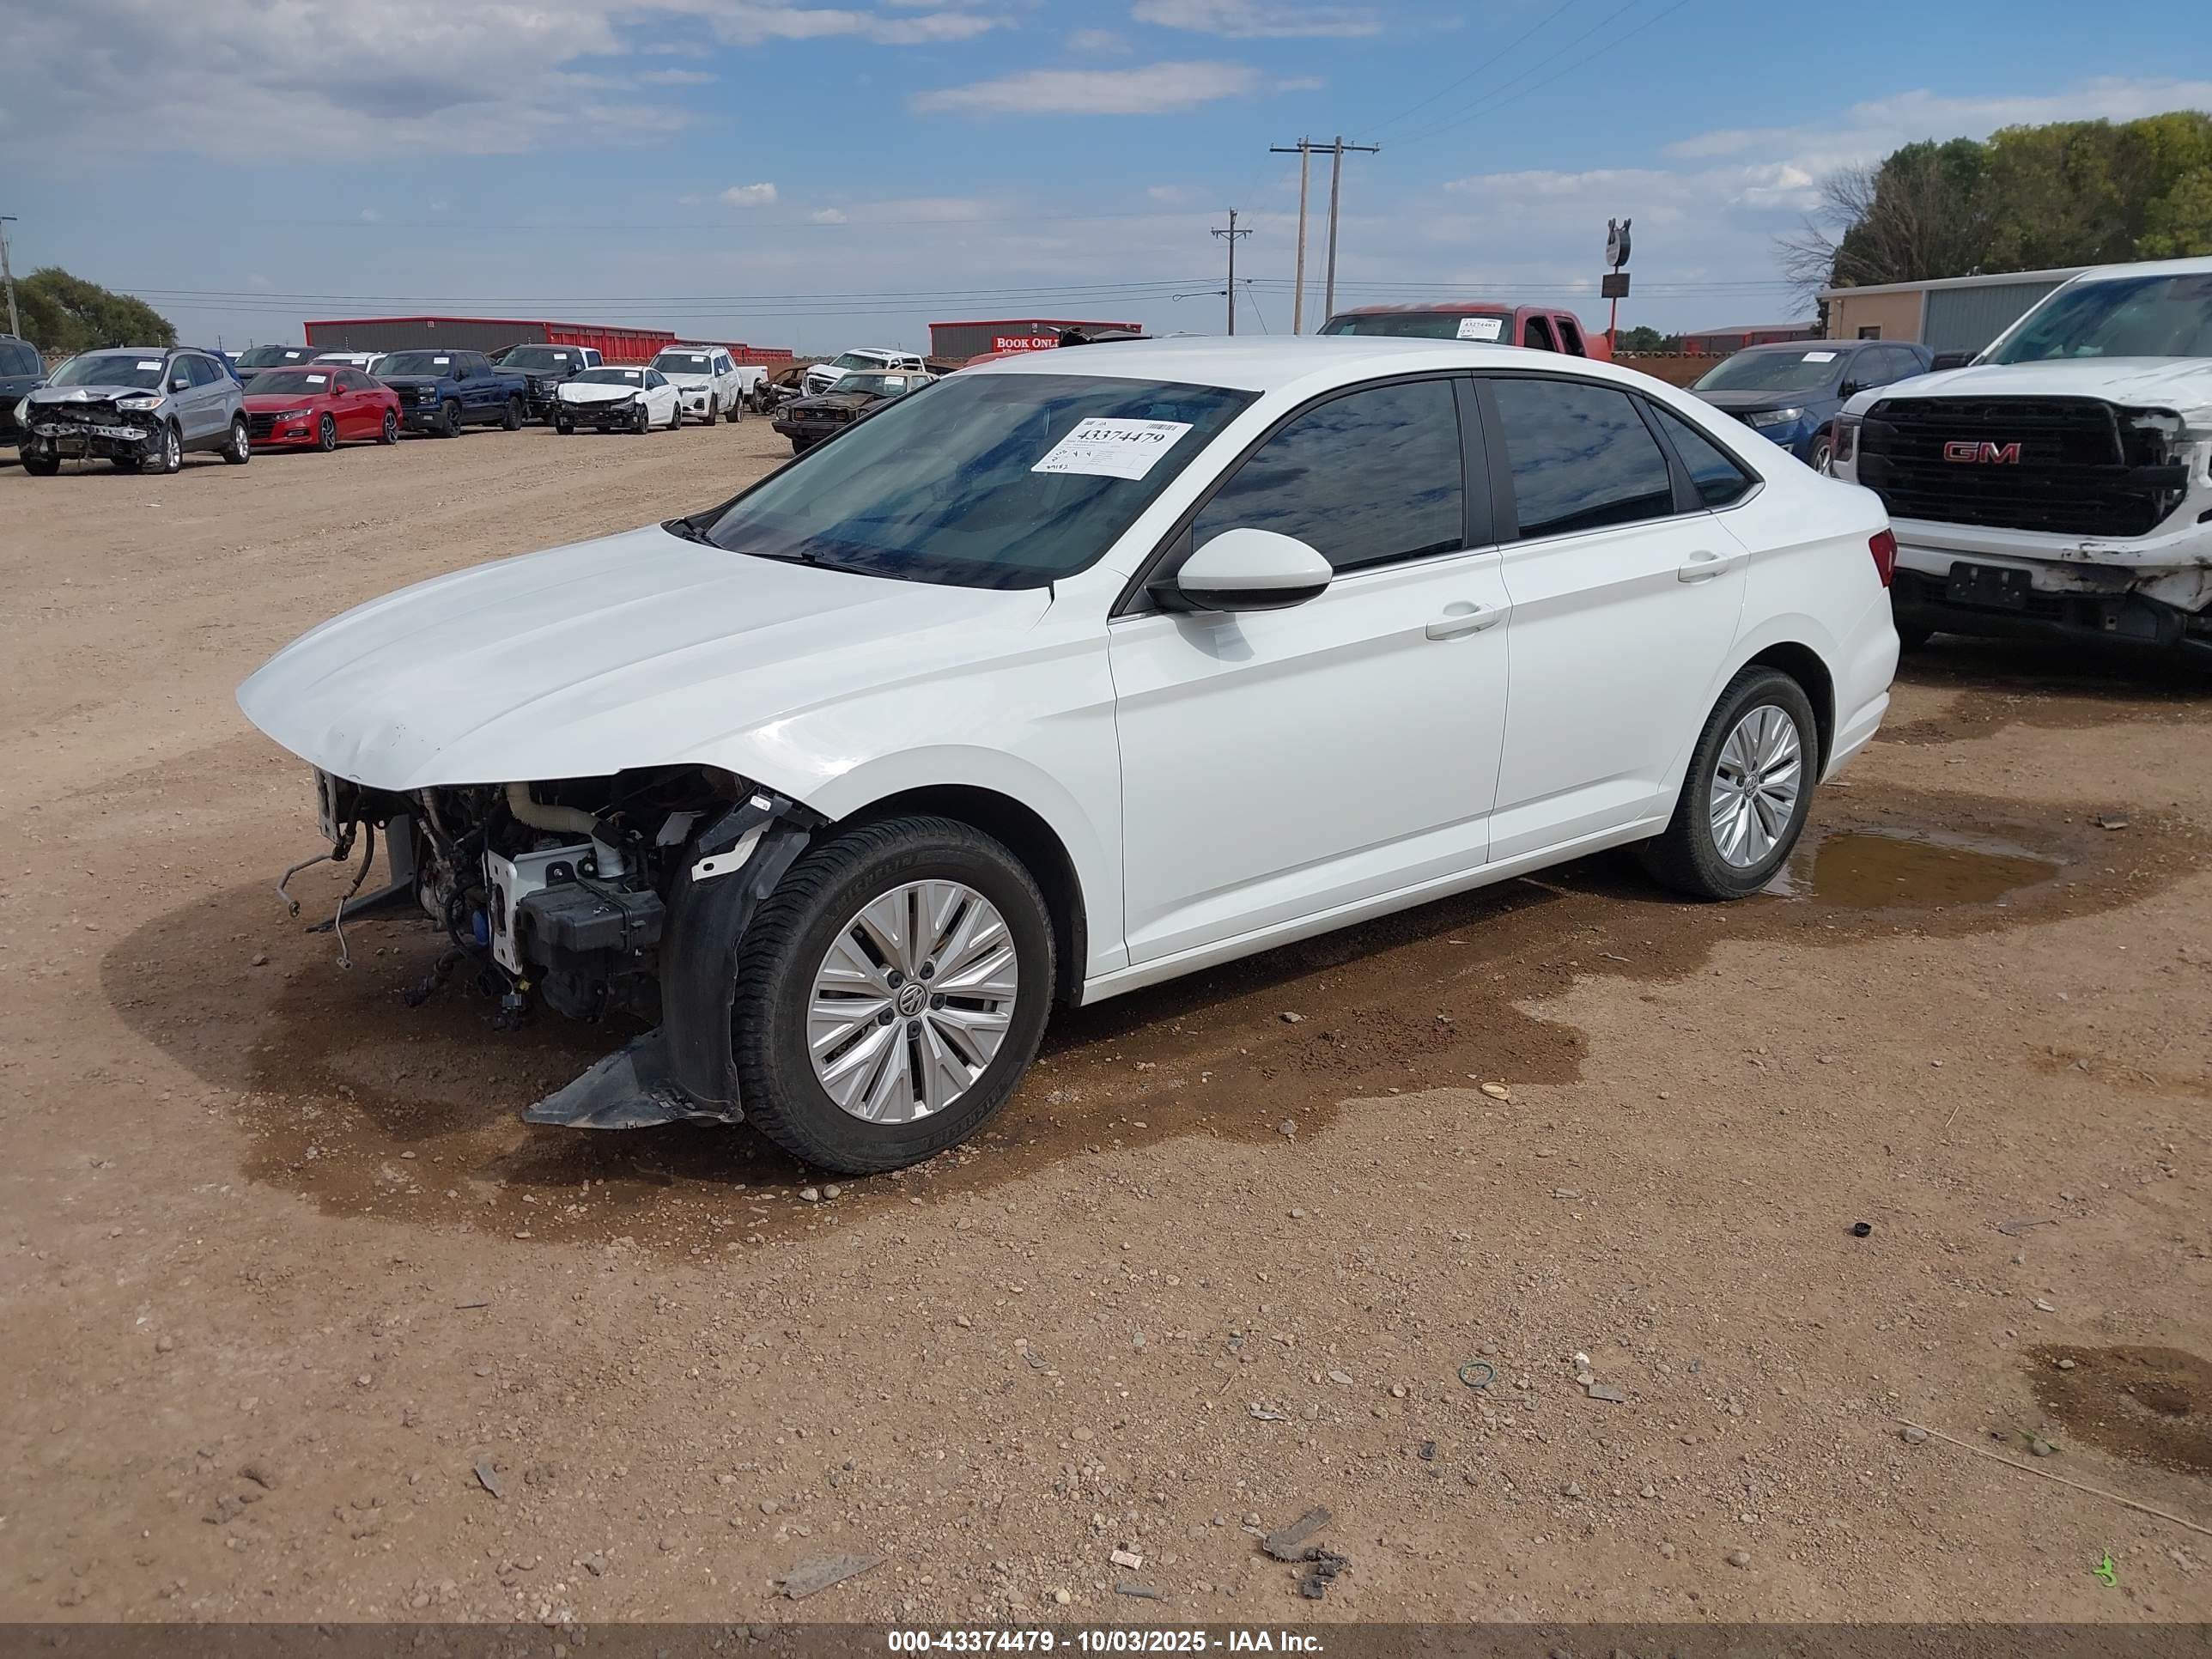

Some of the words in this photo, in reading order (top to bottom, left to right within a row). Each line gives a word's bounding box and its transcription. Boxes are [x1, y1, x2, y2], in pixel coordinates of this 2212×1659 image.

[997, 337, 1030, 348] BOOK
[1078, 429, 1165, 443] 43374479
[1944, 441, 2021, 464] GM
